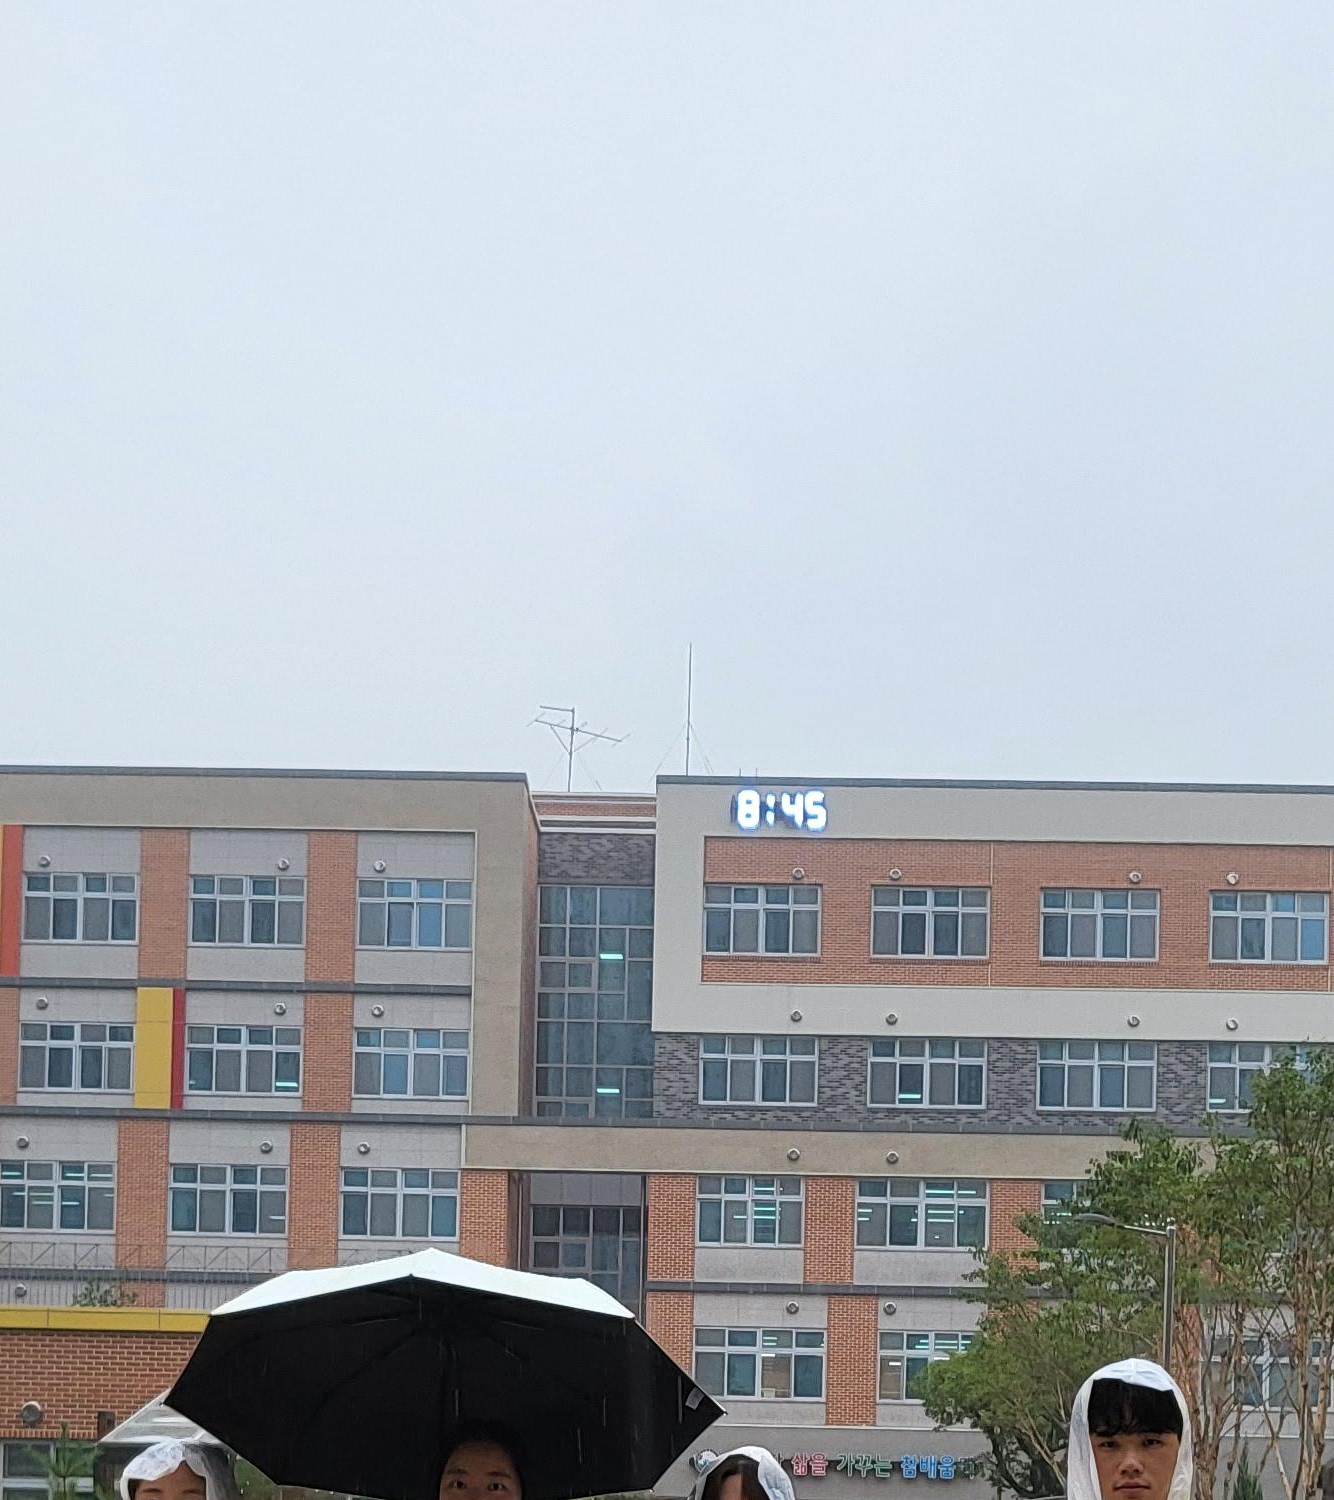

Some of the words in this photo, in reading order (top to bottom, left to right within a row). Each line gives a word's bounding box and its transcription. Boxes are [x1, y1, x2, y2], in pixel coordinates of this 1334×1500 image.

[737, 788, 827, 832] 8:45
[791, 1452, 829, 1477] 삶을
[835, 1452, 893, 1478] 가꾸는
